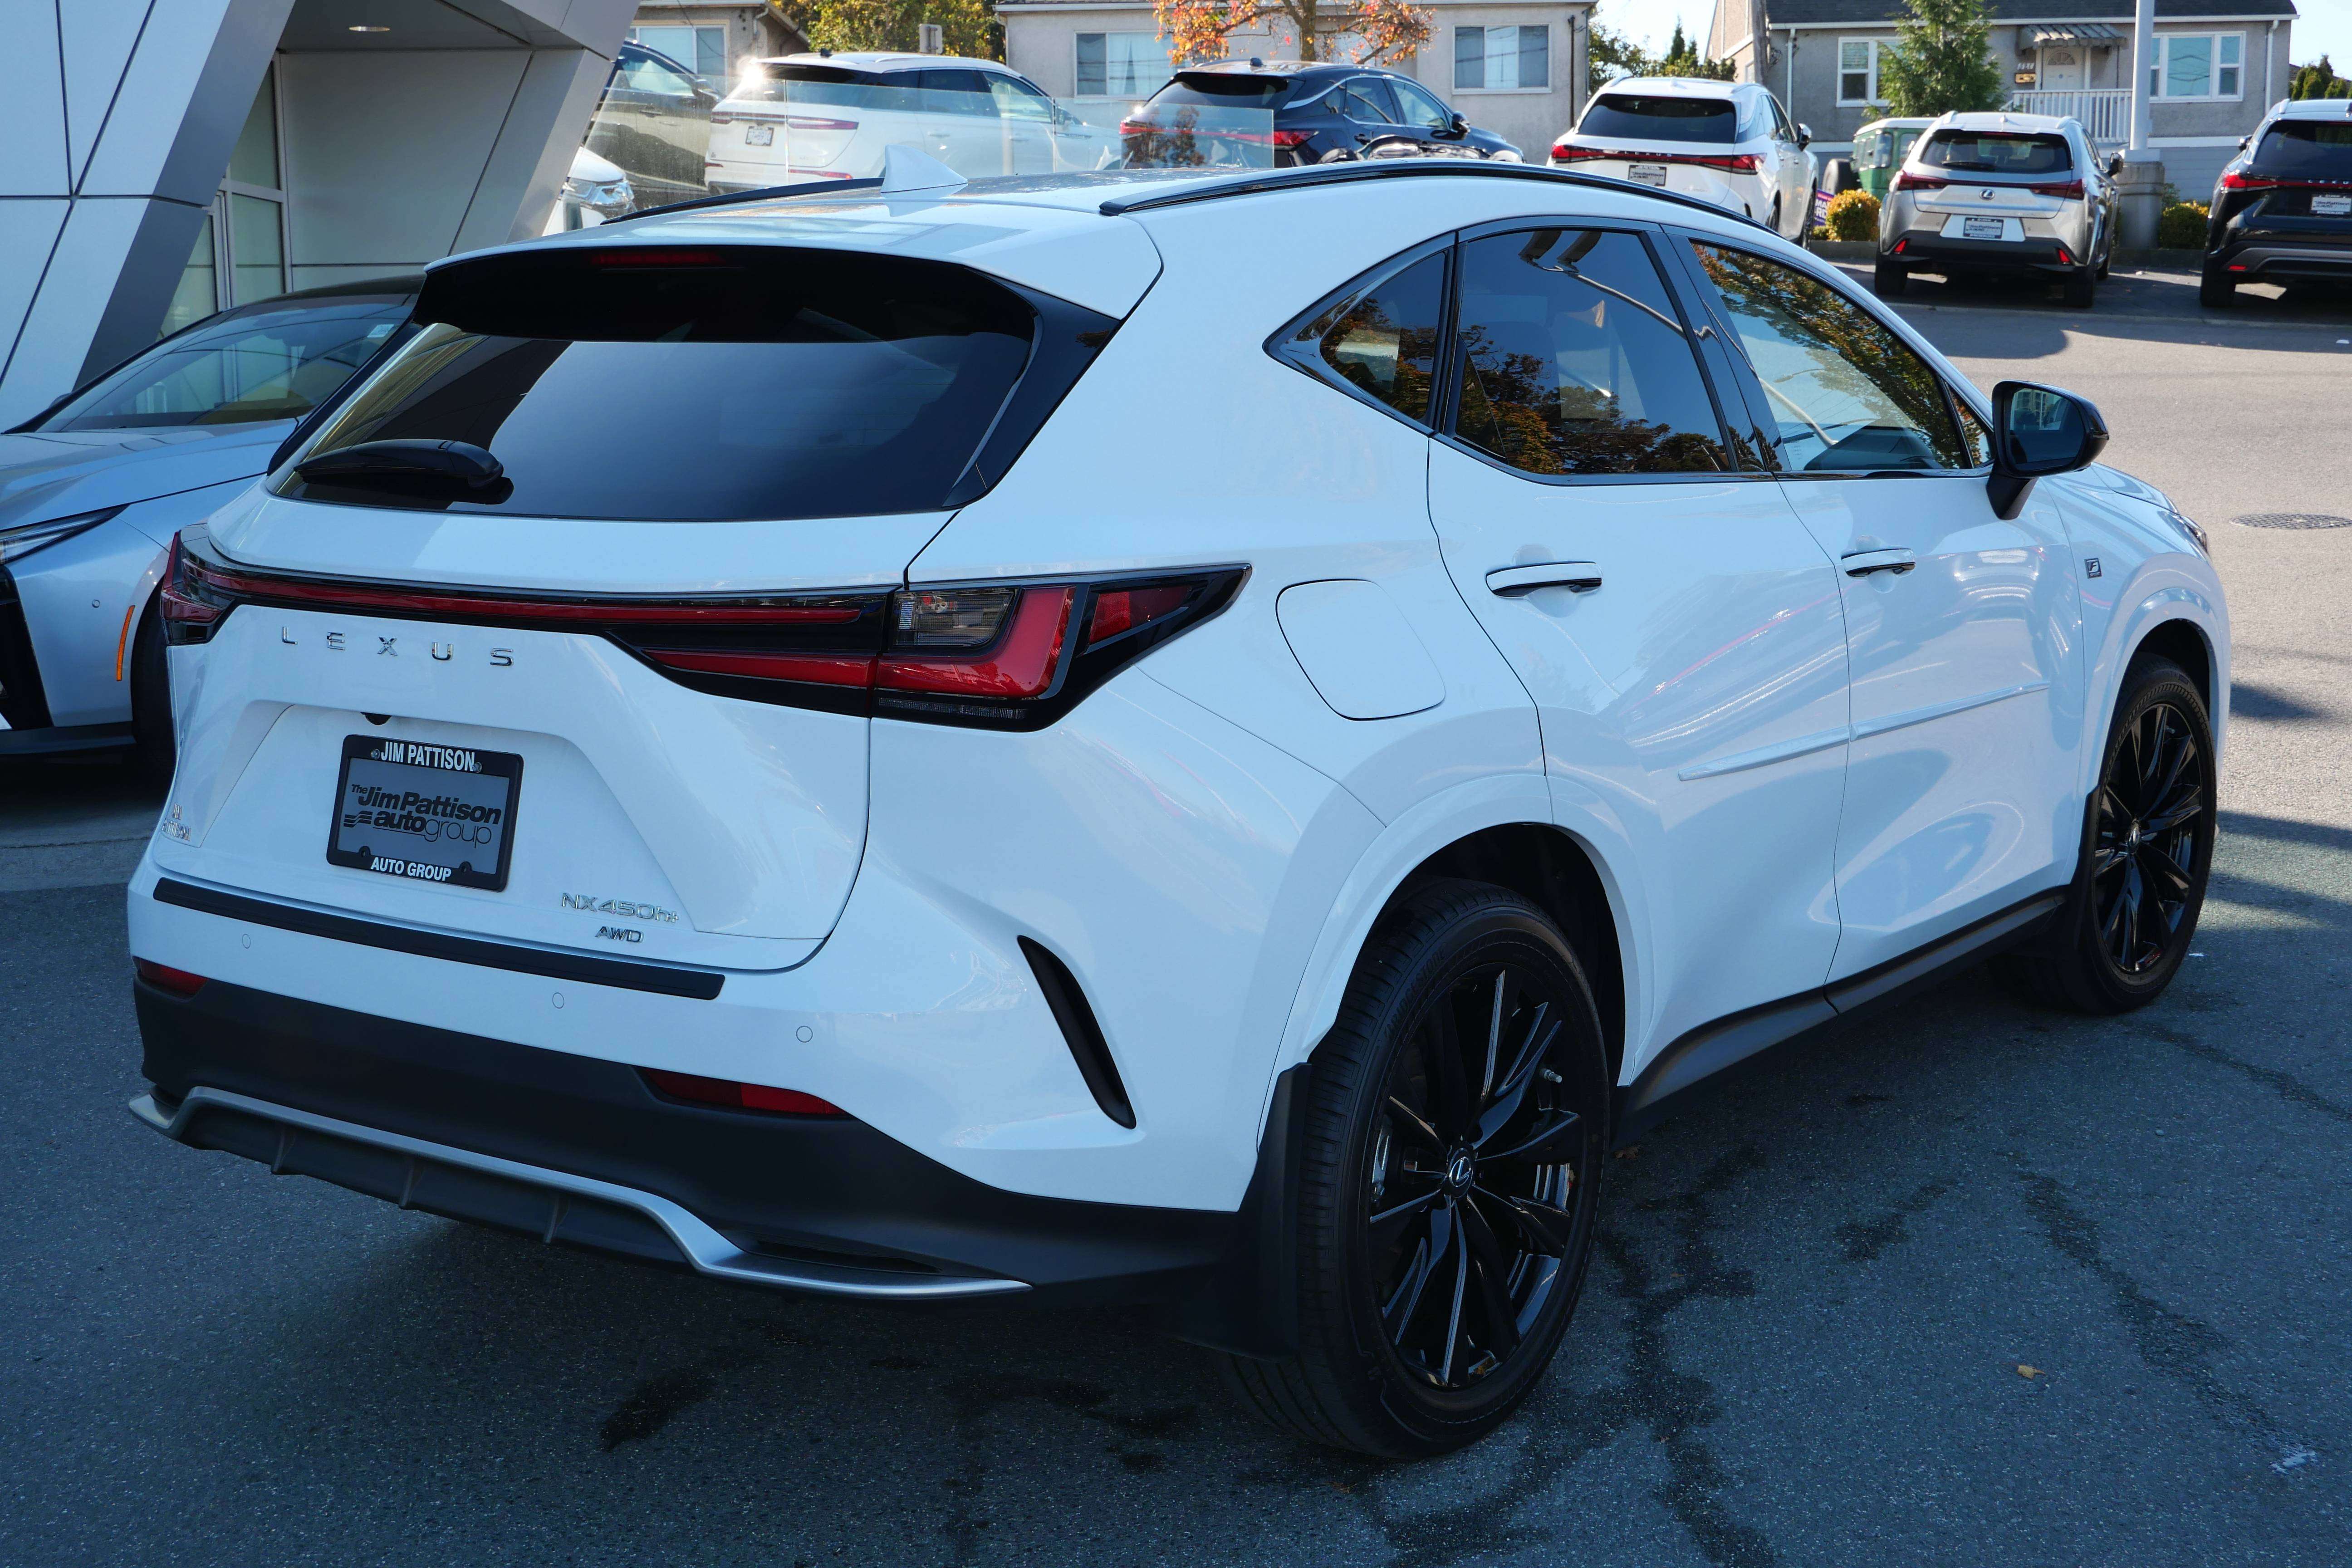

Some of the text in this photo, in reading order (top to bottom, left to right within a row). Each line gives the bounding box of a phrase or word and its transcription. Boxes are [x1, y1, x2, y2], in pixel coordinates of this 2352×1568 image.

[282, 626, 514, 666] LEXUS
[381, 741, 475, 772] JIM PATTISON
[352, 784, 368, 794] The
[371, 857, 451, 882] AUTO GROUP
[561, 892, 679, 923] NX450h+
[595, 926, 644, 943] AWD
